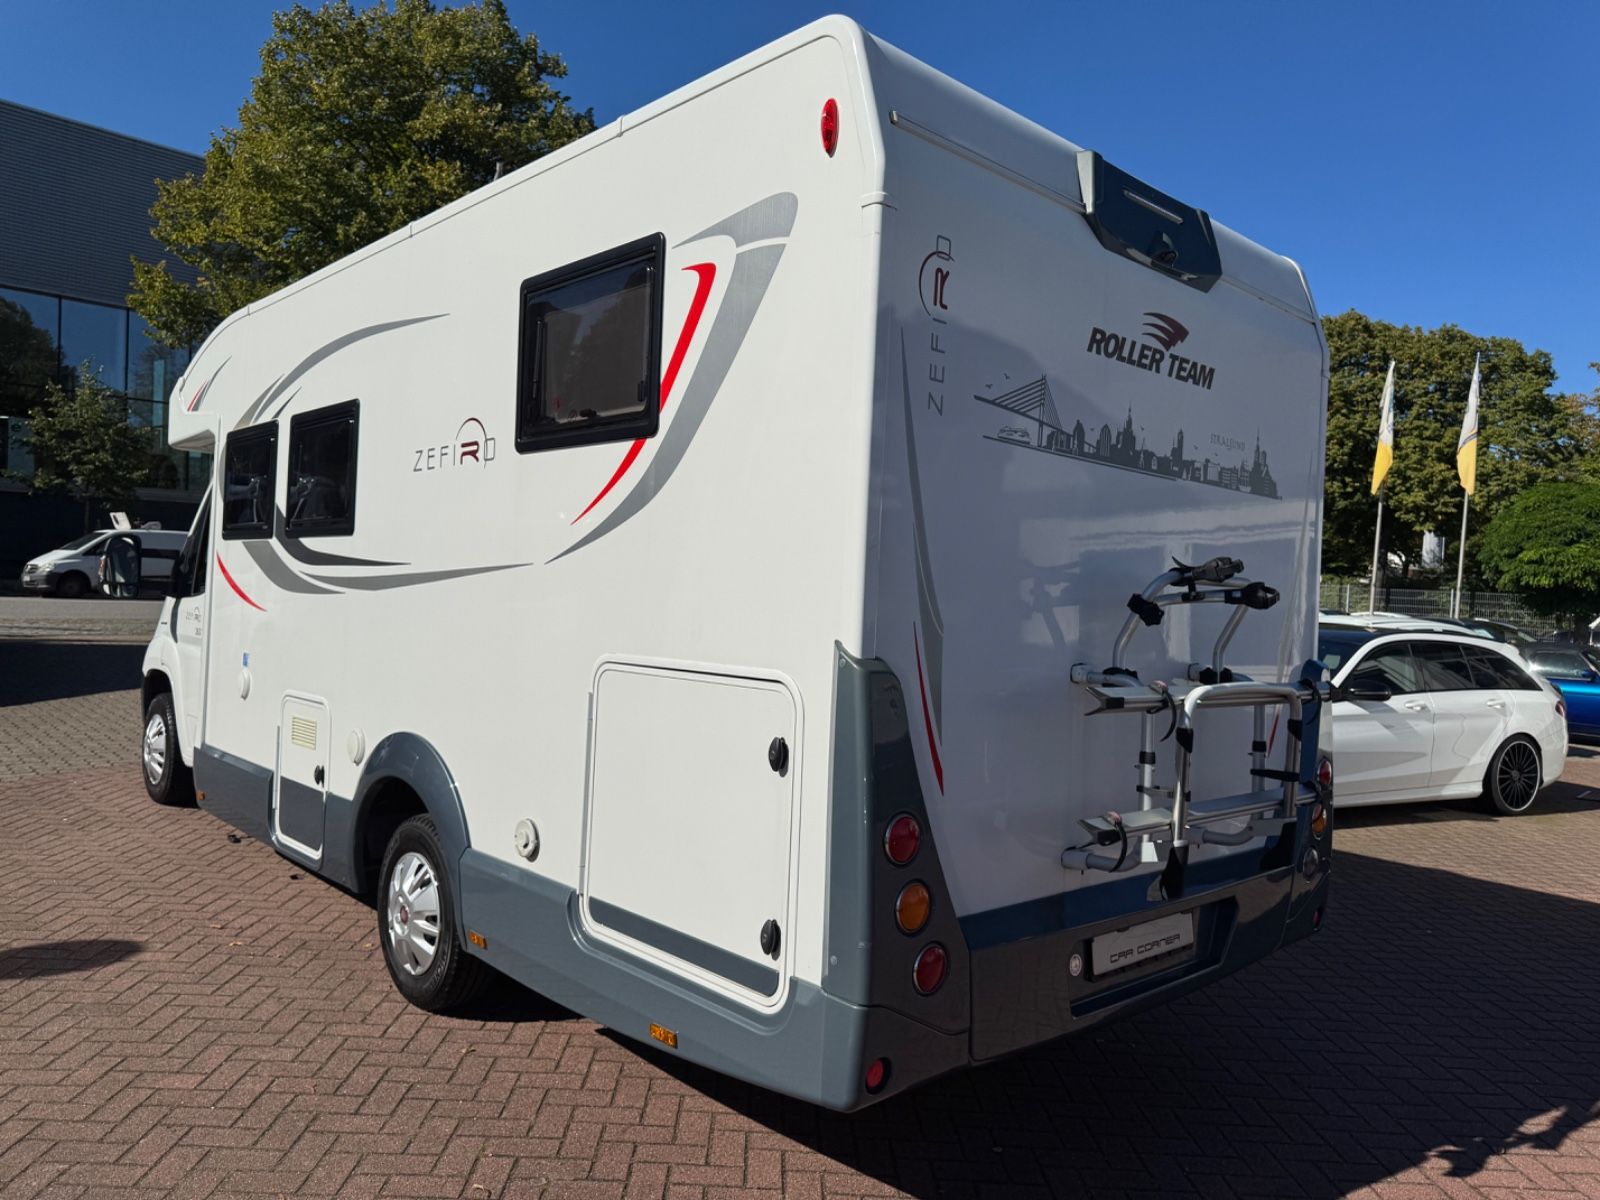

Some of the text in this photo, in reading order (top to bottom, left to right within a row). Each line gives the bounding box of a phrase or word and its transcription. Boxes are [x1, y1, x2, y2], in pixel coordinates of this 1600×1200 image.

[919, 235, 955, 416] ZEFIRO
[1087, 327, 1216, 390] ROLLER TEAM
[413, 418, 496, 472] ZEFIRO
[1110, 948, 1134, 964] CAR
